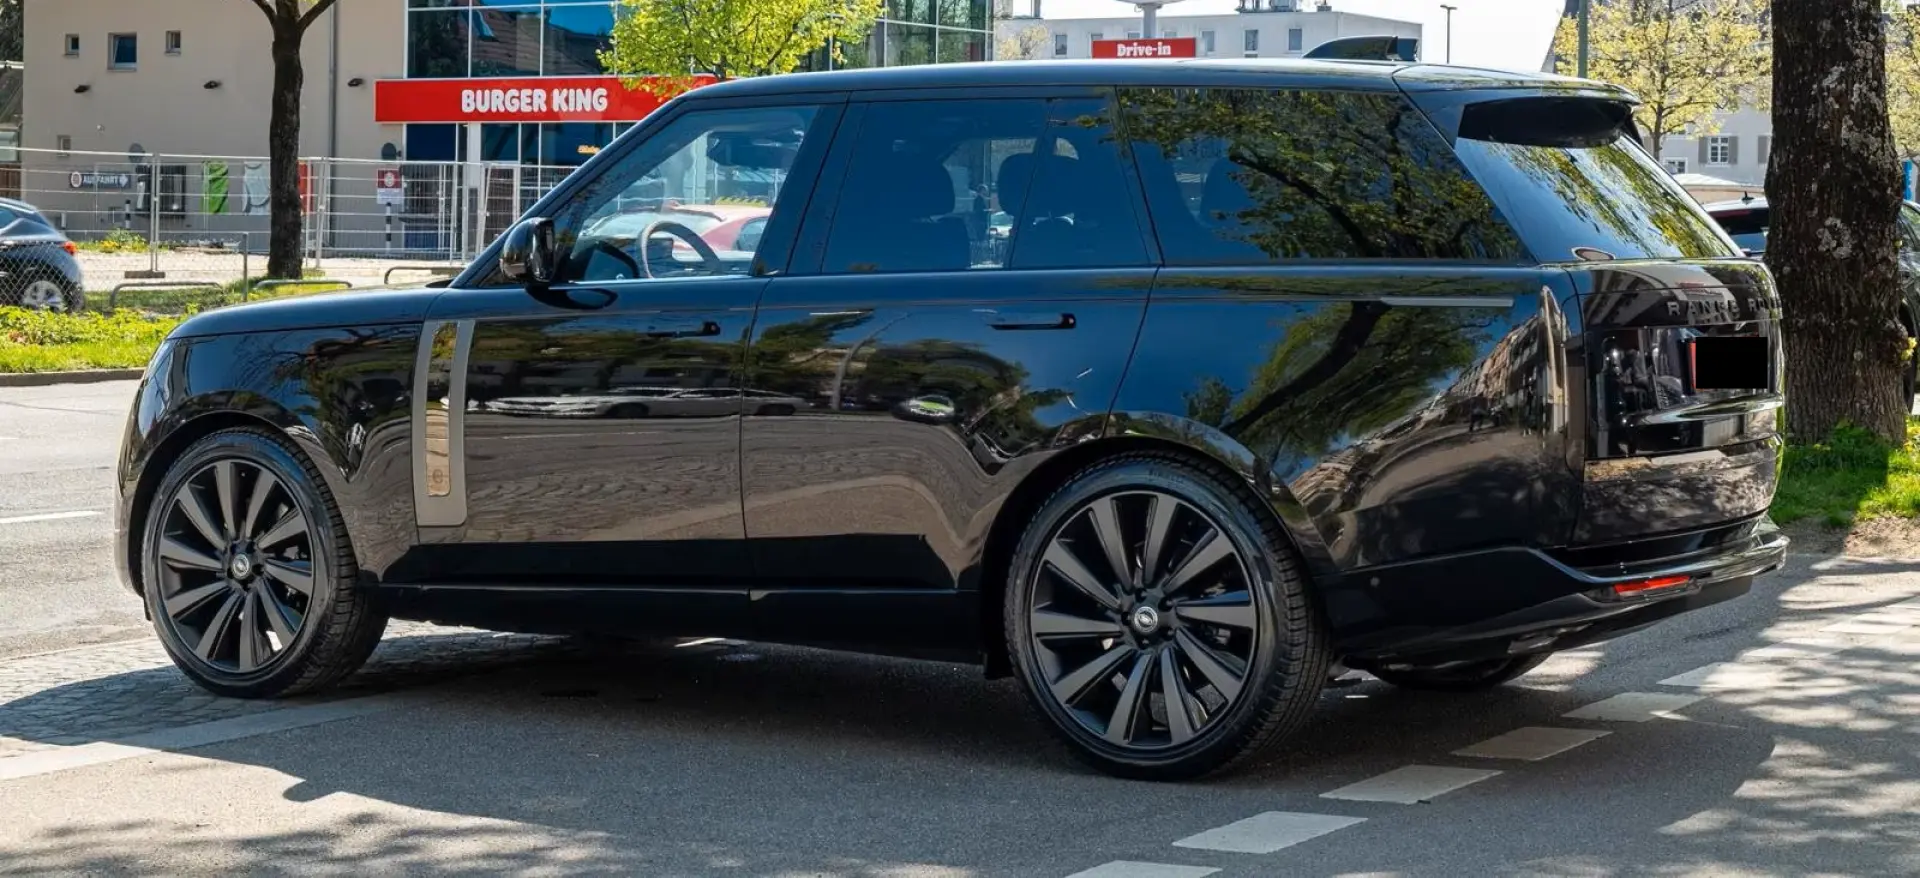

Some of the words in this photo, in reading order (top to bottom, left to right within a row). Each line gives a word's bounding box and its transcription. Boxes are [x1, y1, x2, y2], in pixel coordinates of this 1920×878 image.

[1117, 41, 1171, 57] Drive-in
[461, 89, 547, 113] BURGER
[552, 88, 608, 112] KING
